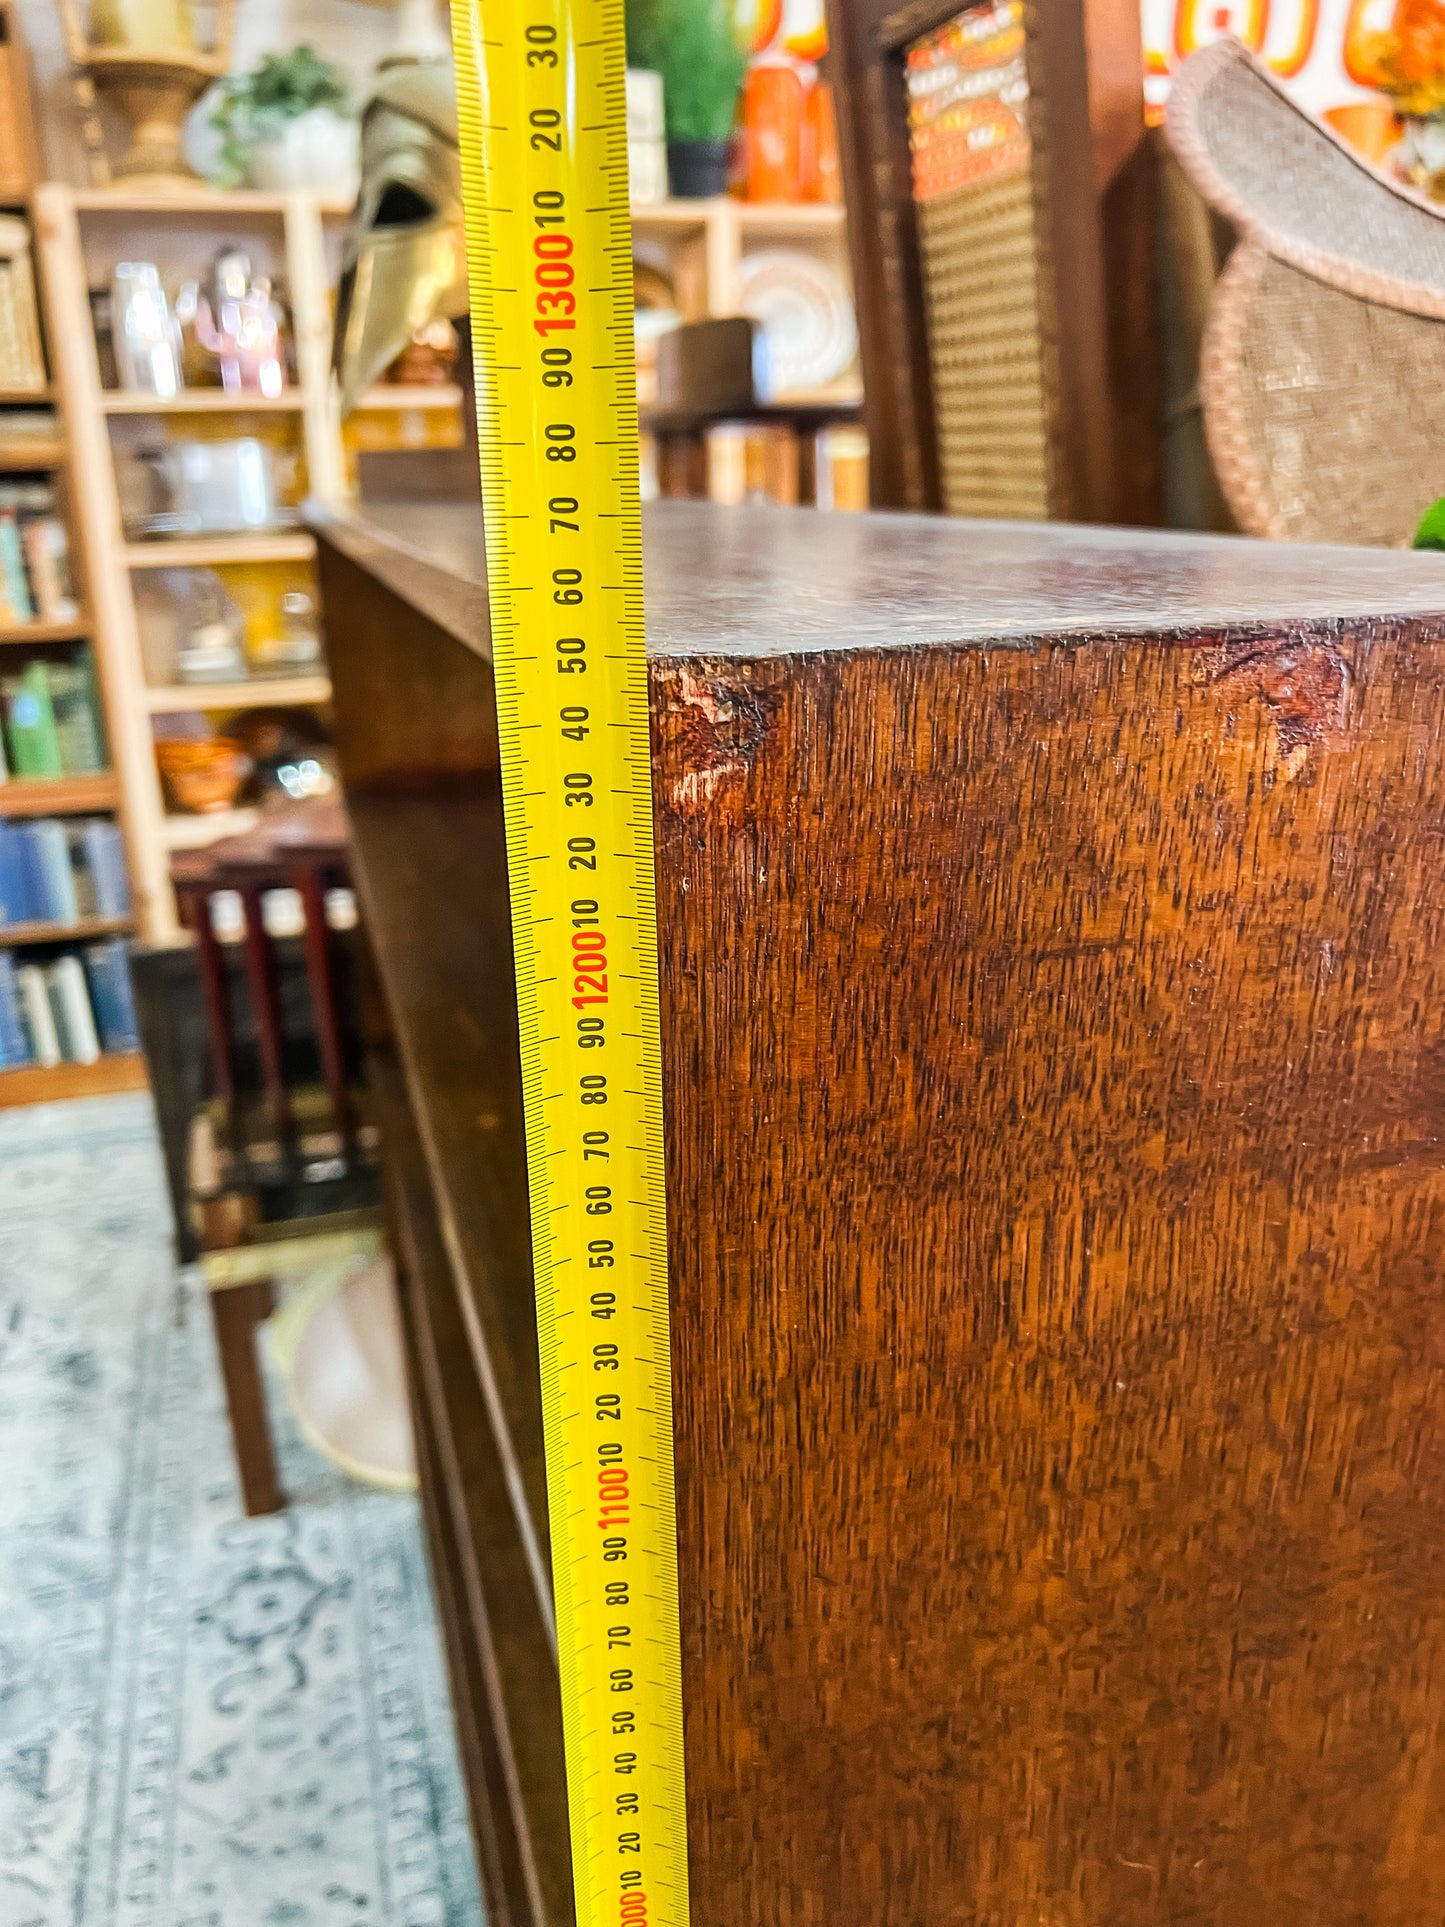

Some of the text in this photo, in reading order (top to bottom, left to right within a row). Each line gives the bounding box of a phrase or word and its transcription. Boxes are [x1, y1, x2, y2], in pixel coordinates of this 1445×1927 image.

[525, 25, 558, 68] 30
[529, 109, 562, 152] 20
[533, 191, 565, 229] 10
[533, 234, 576, 338] 1300
[541, 348, 573, 388] 90
[544, 423, 577, 463] 80
[548, 497, 580, 534] 70
[552, 568, 583, 606] 60
[555, 637, 587, 674] 50
[559, 706, 590, 742] 40
[563, 773, 594, 808] 30
[567, 837, 597, 871] 20
[570, 899, 599, 928] 10
[571, 931, 609, 1010] 1200
[576, 1017, 605, 1049] 90
[579, 1075, 608, 1105] 80
[582, 1131, 610, 1161] 70
[585, 1185, 612, 1215] 60
[587, 1239, 615, 1268] 50
[590, 1292, 617, 1320] 40
[592, 1343, 619, 1371] 30
[595, 1393, 621, 1421] 20
[597, 1442, 623, 1467] 10
[597, 1468, 631, 1530] 1100
[602, 1537, 628, 1562] 90
[604, 1581, 630, 1606] 80
[607, 1625, 632, 1650] 70
[609, 1668, 634, 1692] 60
[611, 1711, 636, 1735] 50
[614, 1752, 637, 1775] 40
[615, 1793, 639, 1816] 30
[617, 1832, 641, 1854] 20
[619, 1870, 643, 1890] 10
[619, 1891, 648, 1927] 000
